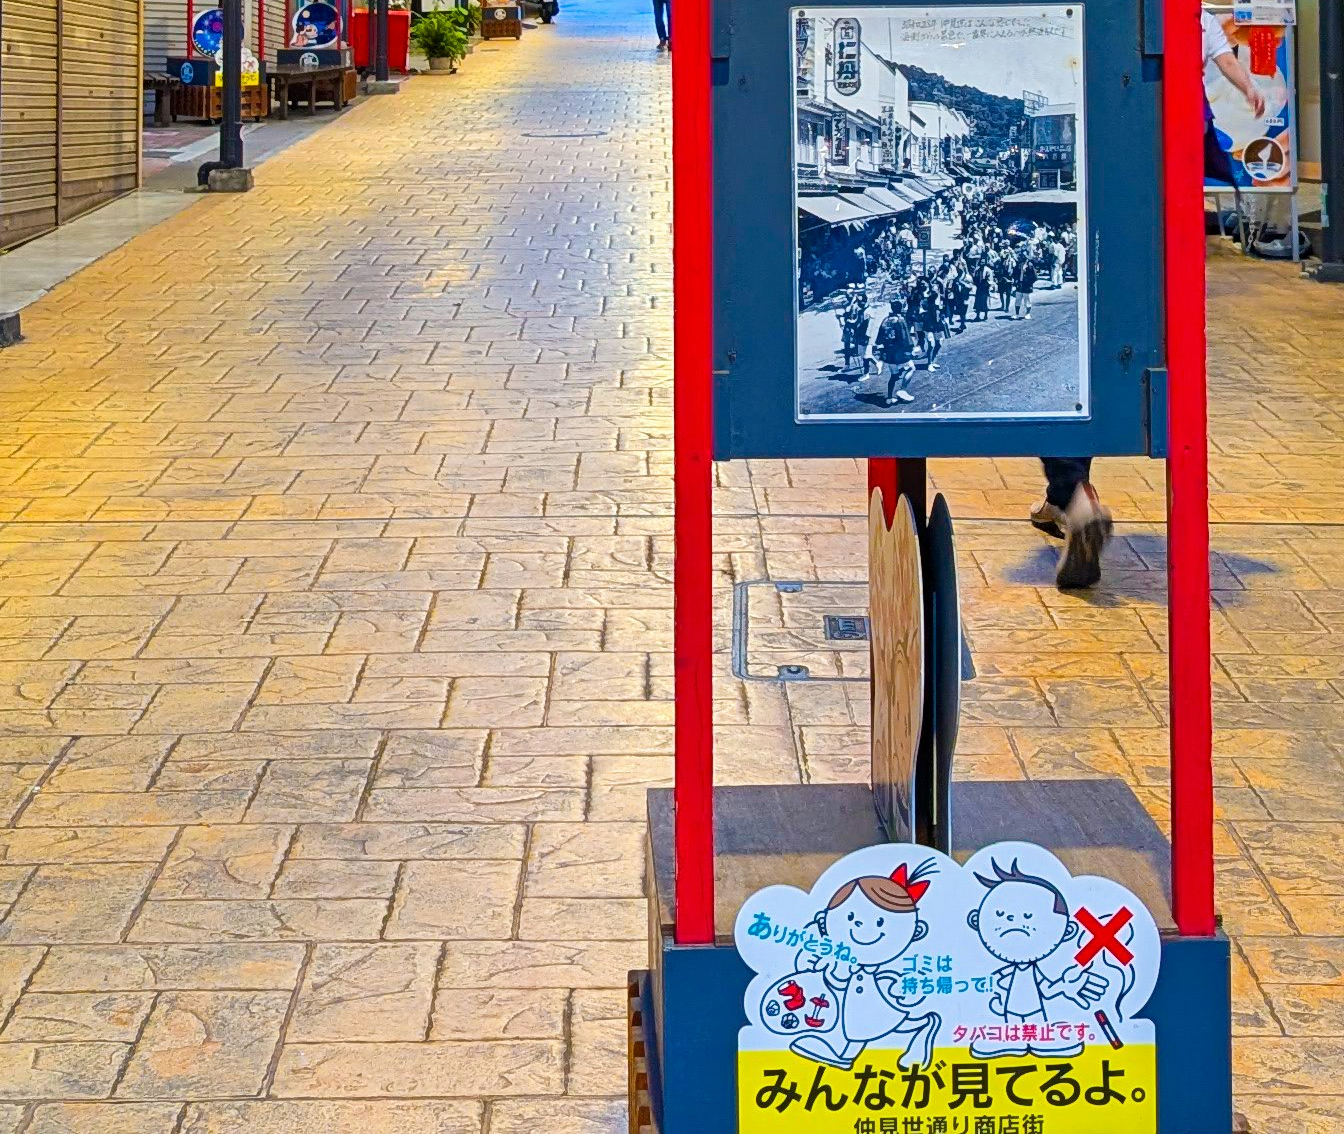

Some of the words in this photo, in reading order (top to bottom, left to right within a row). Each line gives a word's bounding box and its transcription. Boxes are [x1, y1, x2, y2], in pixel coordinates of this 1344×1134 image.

[747, 911, 858, 964] ありがとうね。
[902, 954, 953, 974] ゴミは
[953, 1024, 1096, 1043] タバコは禁止です。
[755, 1059, 1146, 1113] みんなが見てるよ。
[853, 1114, 1044, 1134] 仲見世通り商店街
